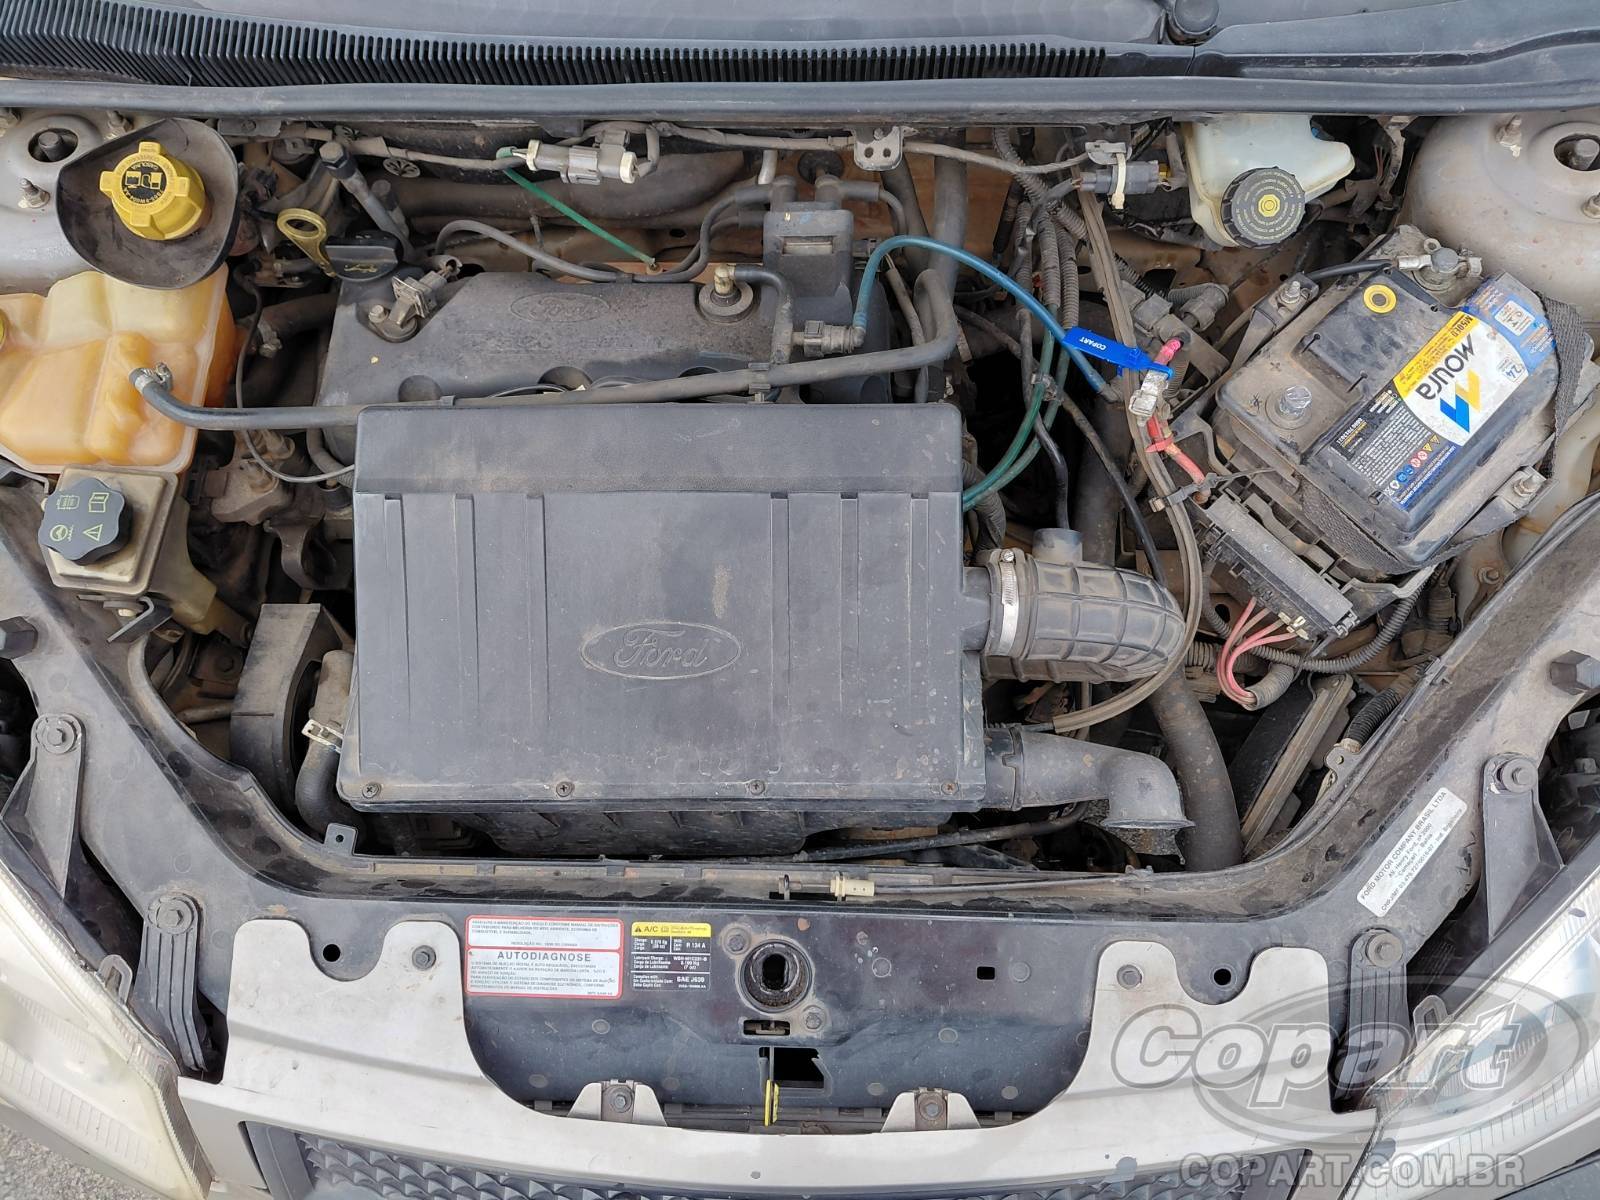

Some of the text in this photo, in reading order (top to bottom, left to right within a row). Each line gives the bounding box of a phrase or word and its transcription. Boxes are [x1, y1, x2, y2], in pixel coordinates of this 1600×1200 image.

[1079, 336, 1107, 351] COPART
[1504, 363, 1522, 380] 24
[614, 628, 707, 668] Ford
[1360, 791, 1445, 899] FORD MOTOR COMPANY BRASIL LTDA
[497, 951, 591, 962] AUTODIAGNOSE
